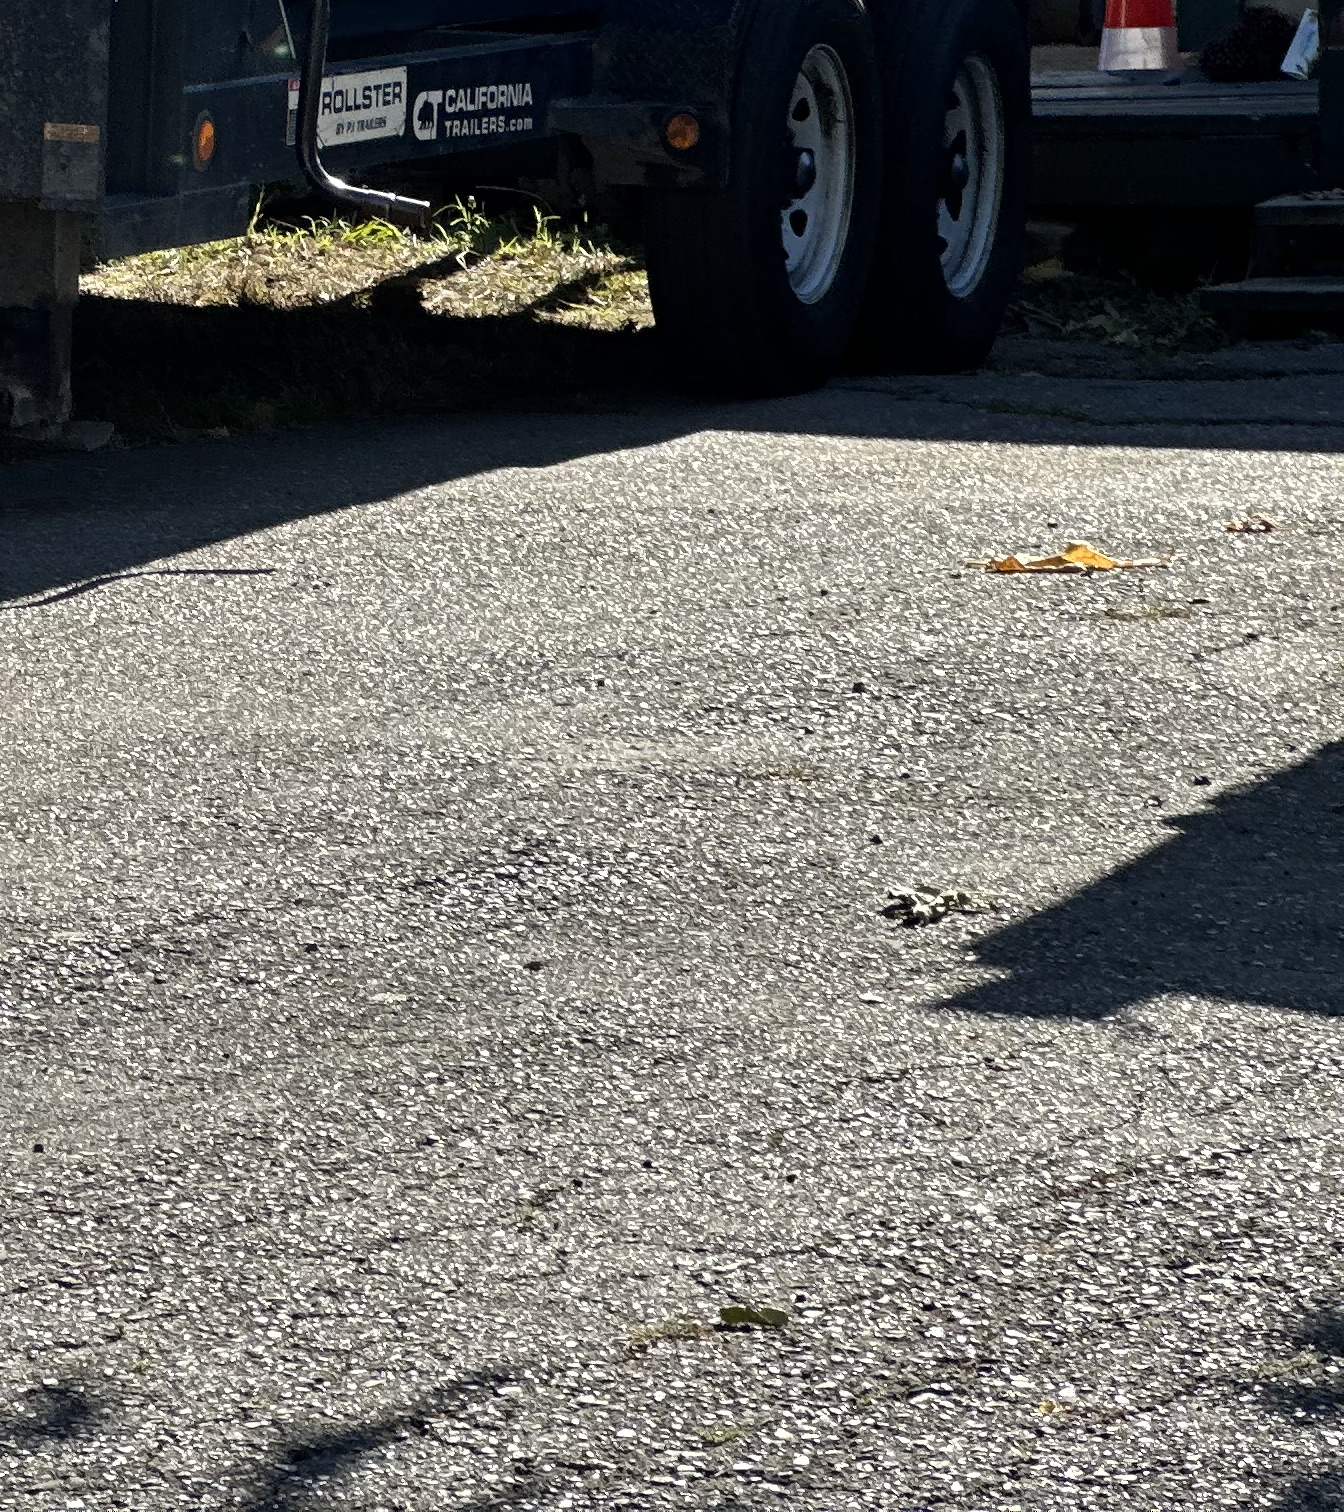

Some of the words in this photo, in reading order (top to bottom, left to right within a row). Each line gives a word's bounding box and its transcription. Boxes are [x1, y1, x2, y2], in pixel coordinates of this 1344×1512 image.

[321, 80, 403, 117] ROLLSTER
[445, 83, 533, 114] CALIFORNIA
[444, 116, 533, 138] TRAILERS.com
